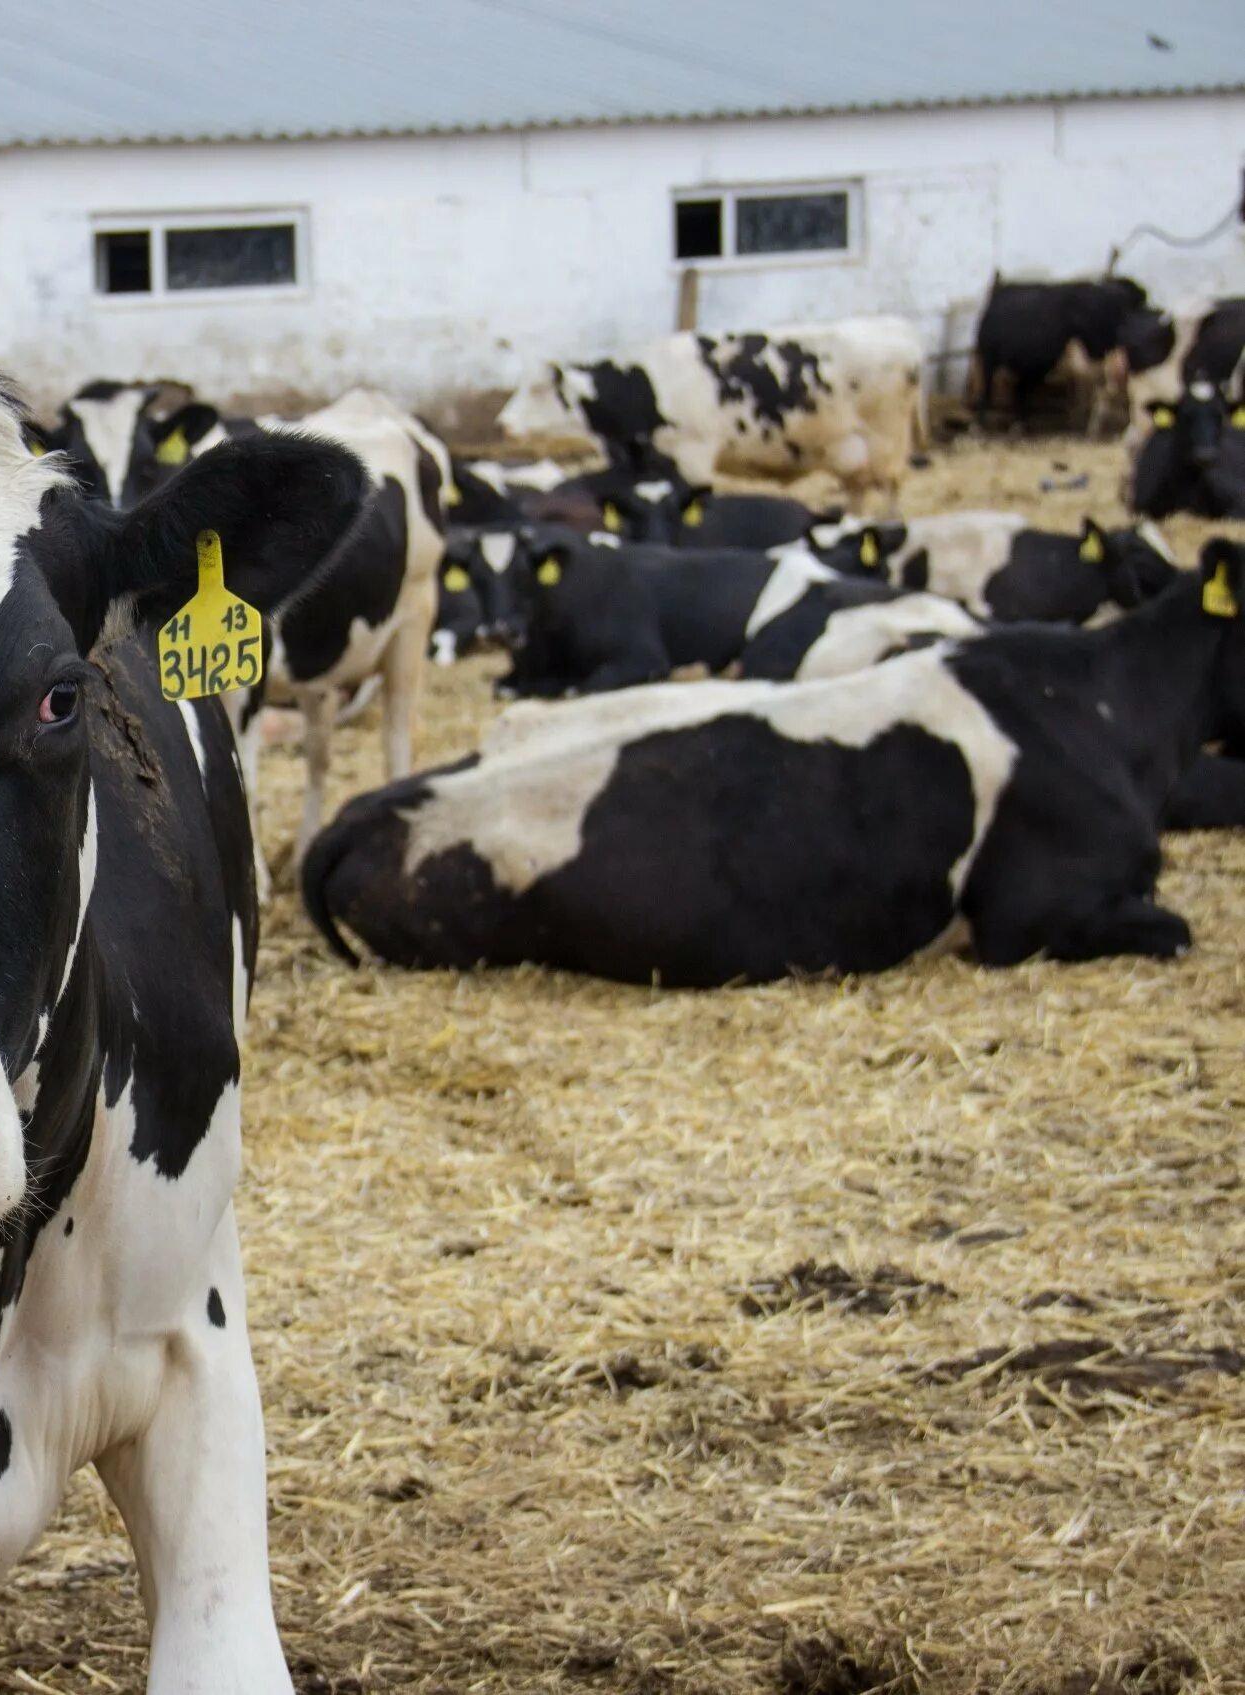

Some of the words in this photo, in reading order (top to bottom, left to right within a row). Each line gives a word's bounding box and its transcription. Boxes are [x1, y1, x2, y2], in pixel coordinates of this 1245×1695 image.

[166, 615, 189, 642] 11
[222, 604, 247, 632] 13
[163, 636, 259, 698] 3425
